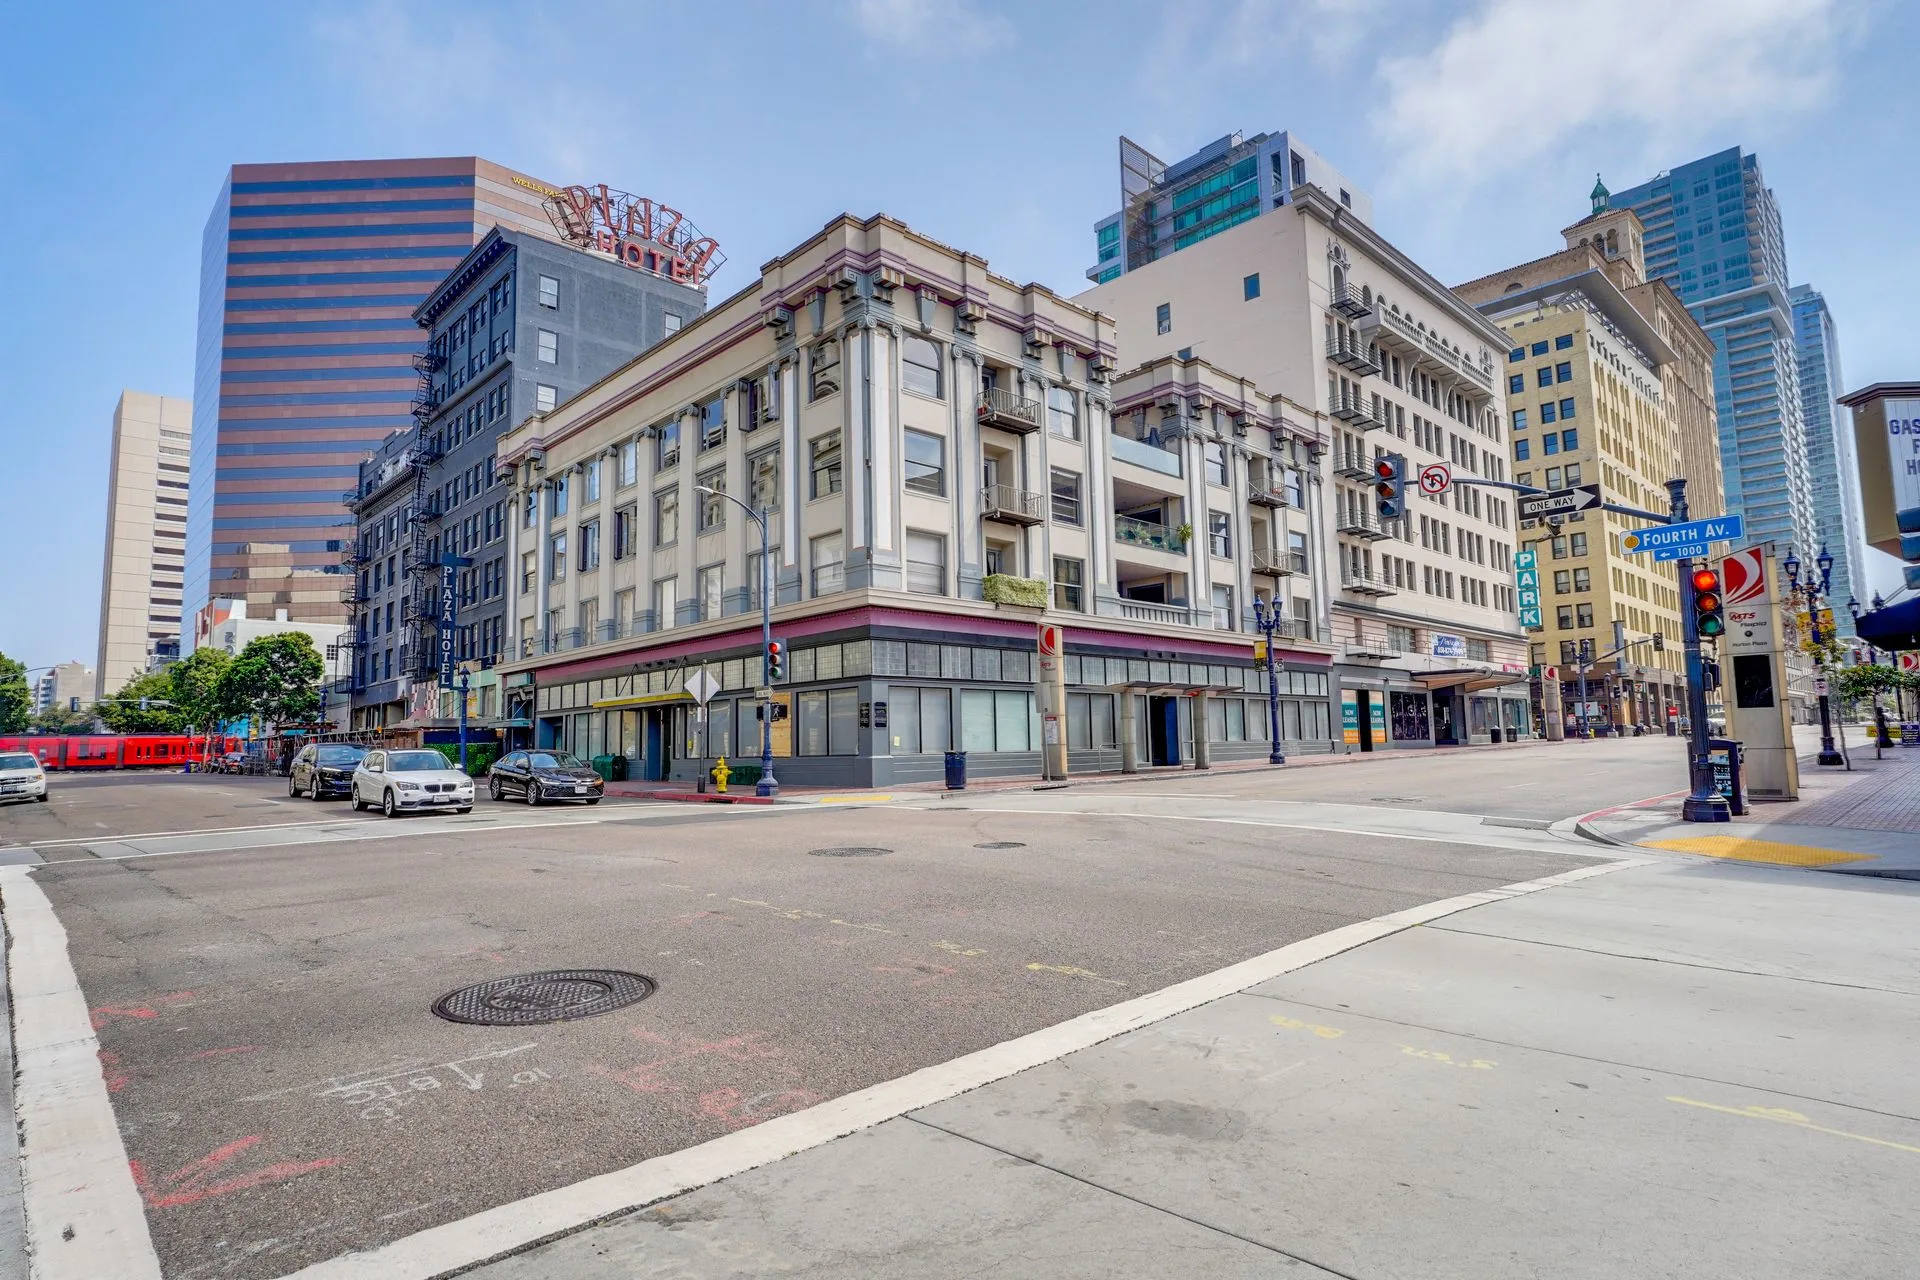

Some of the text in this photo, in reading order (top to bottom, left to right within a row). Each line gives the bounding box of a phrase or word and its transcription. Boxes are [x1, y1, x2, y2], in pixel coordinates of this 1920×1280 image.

[512, 176, 543, 193] WELLS
[562, 184, 720, 271] PLAZA
[1529, 496, 1575, 511] ONE WAY
[1642, 528, 1698, 546] FOURTH
[1678, 545, 1702, 557] 1000
[1518, 553, 1538, 624] PARK
[1730, 612, 1756, 620] MTS
[441, 566, 453, 685] PLAZA HOTEL
